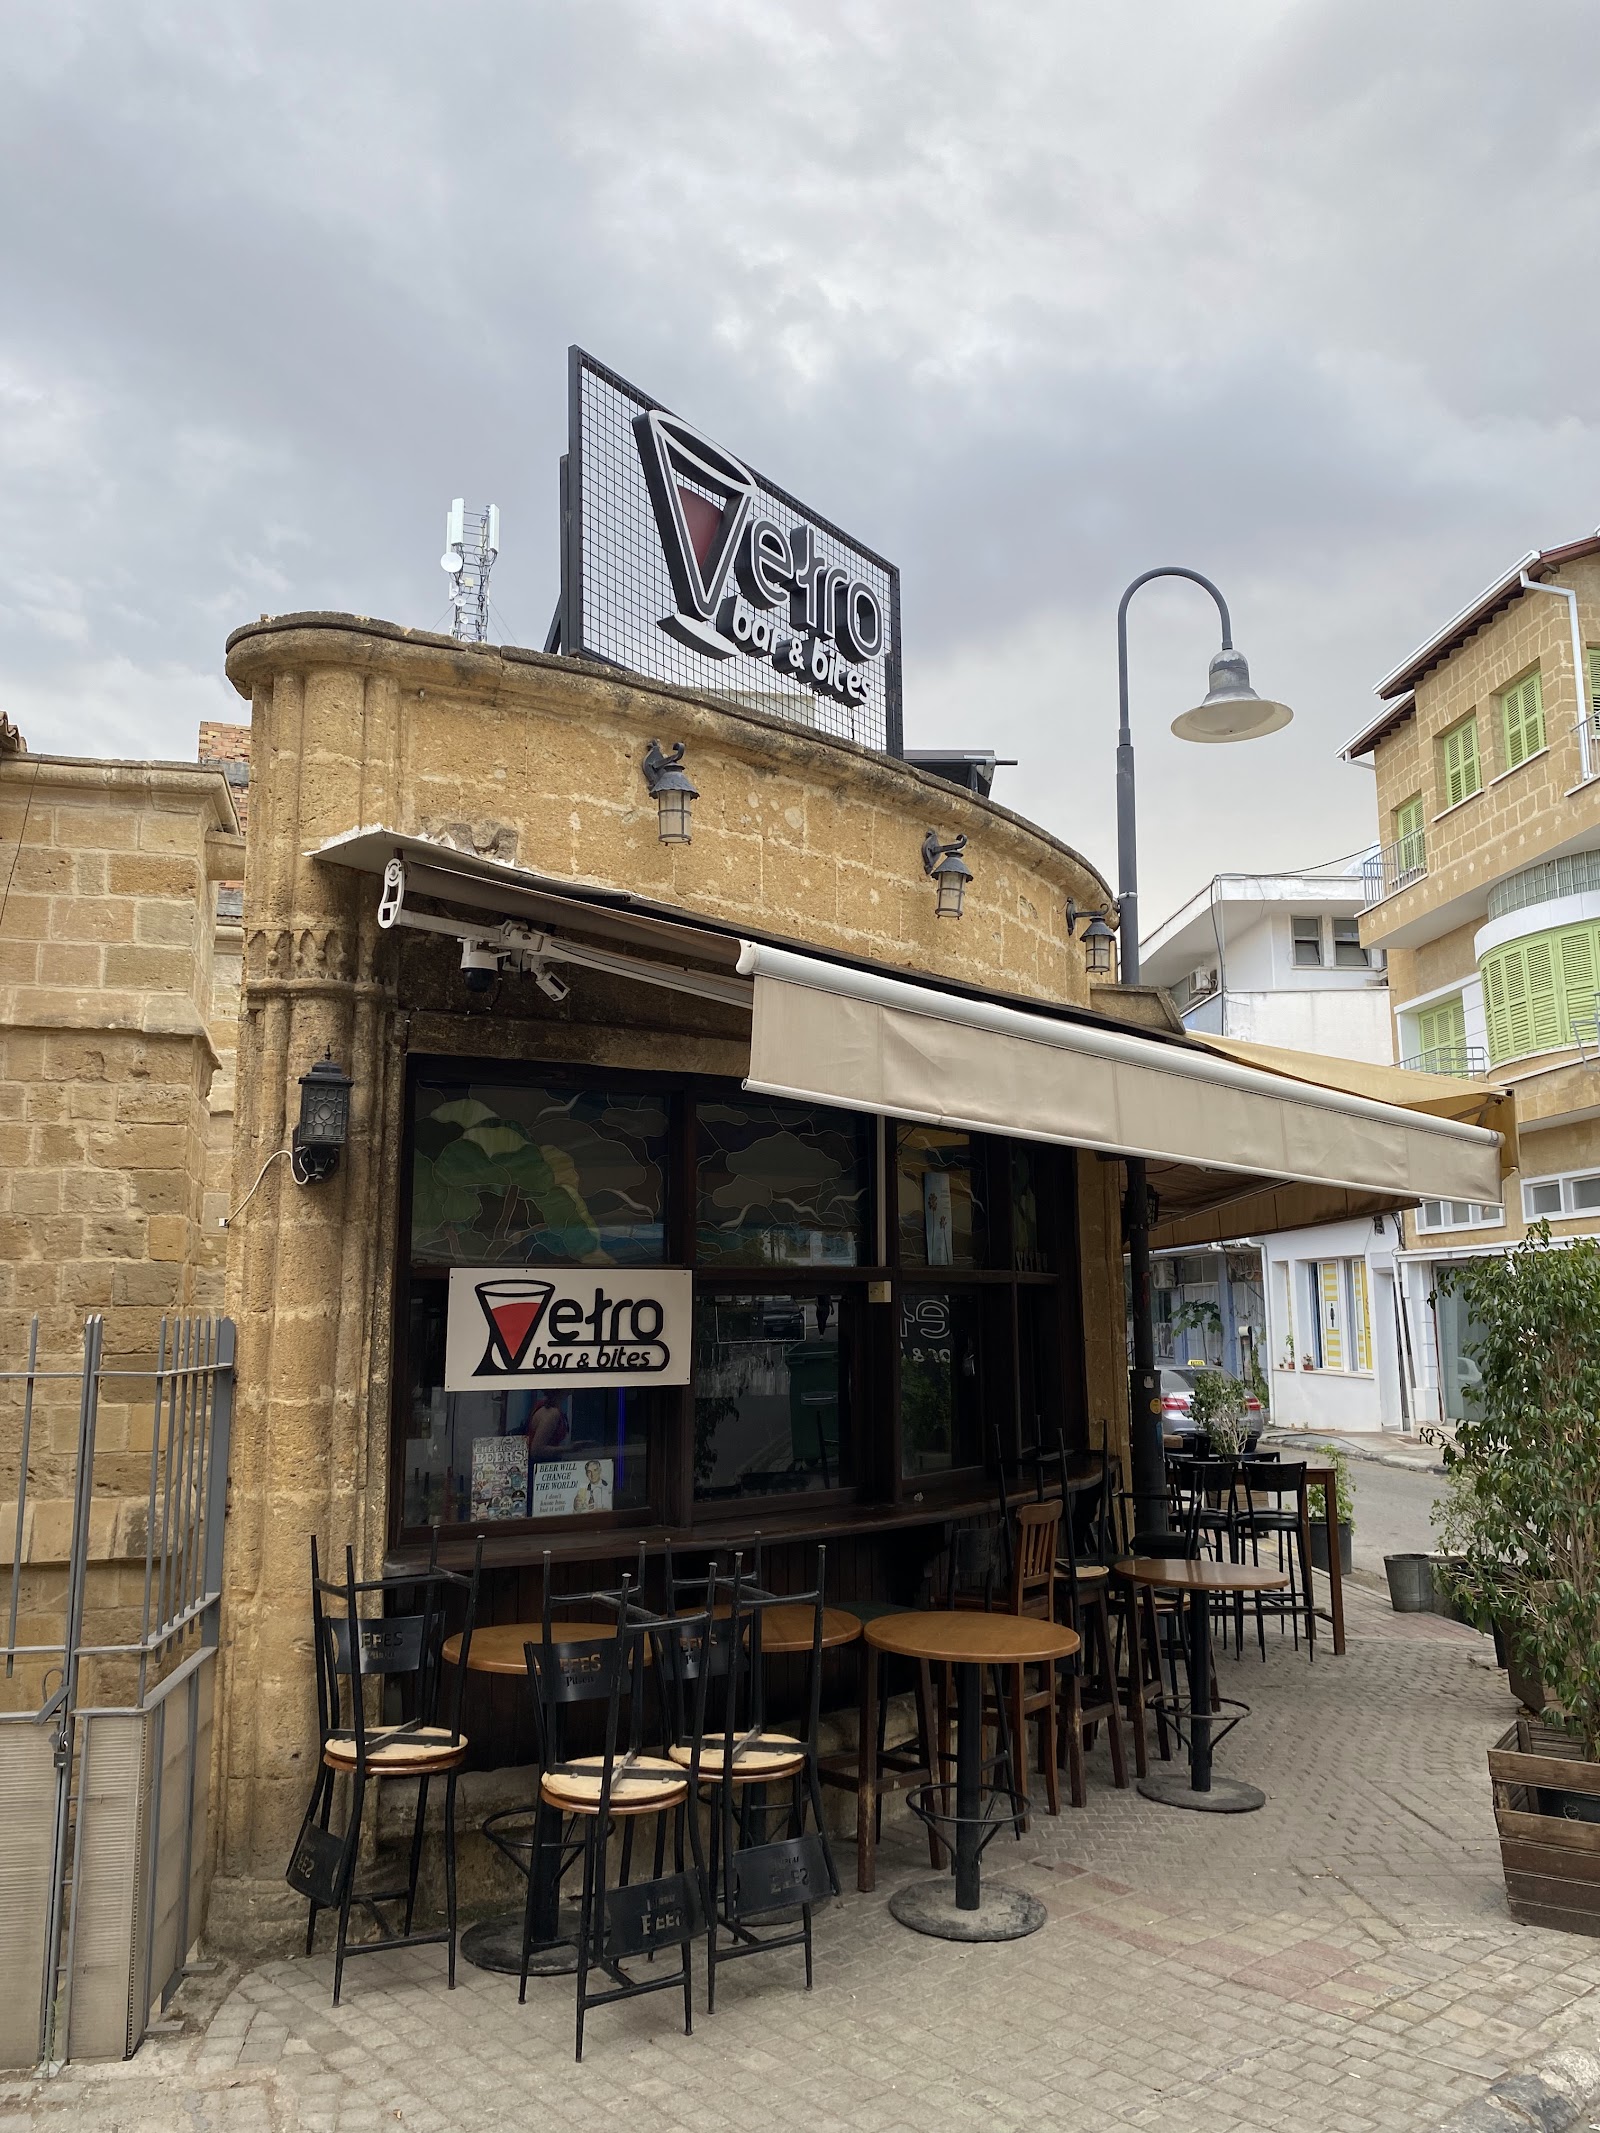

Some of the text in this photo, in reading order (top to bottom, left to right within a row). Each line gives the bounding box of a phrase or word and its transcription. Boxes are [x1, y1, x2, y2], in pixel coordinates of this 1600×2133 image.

[724, 596, 873, 706] bar & bites
[533, 1346, 651, 1369] bar & bites
[475, 1450, 527, 1463] BEERS!
[539, 1463, 577, 1473] BEER WILL
[541, 1472, 571, 1482] CHANGE
[535, 1481, 579, 1491] THE WORLD!
